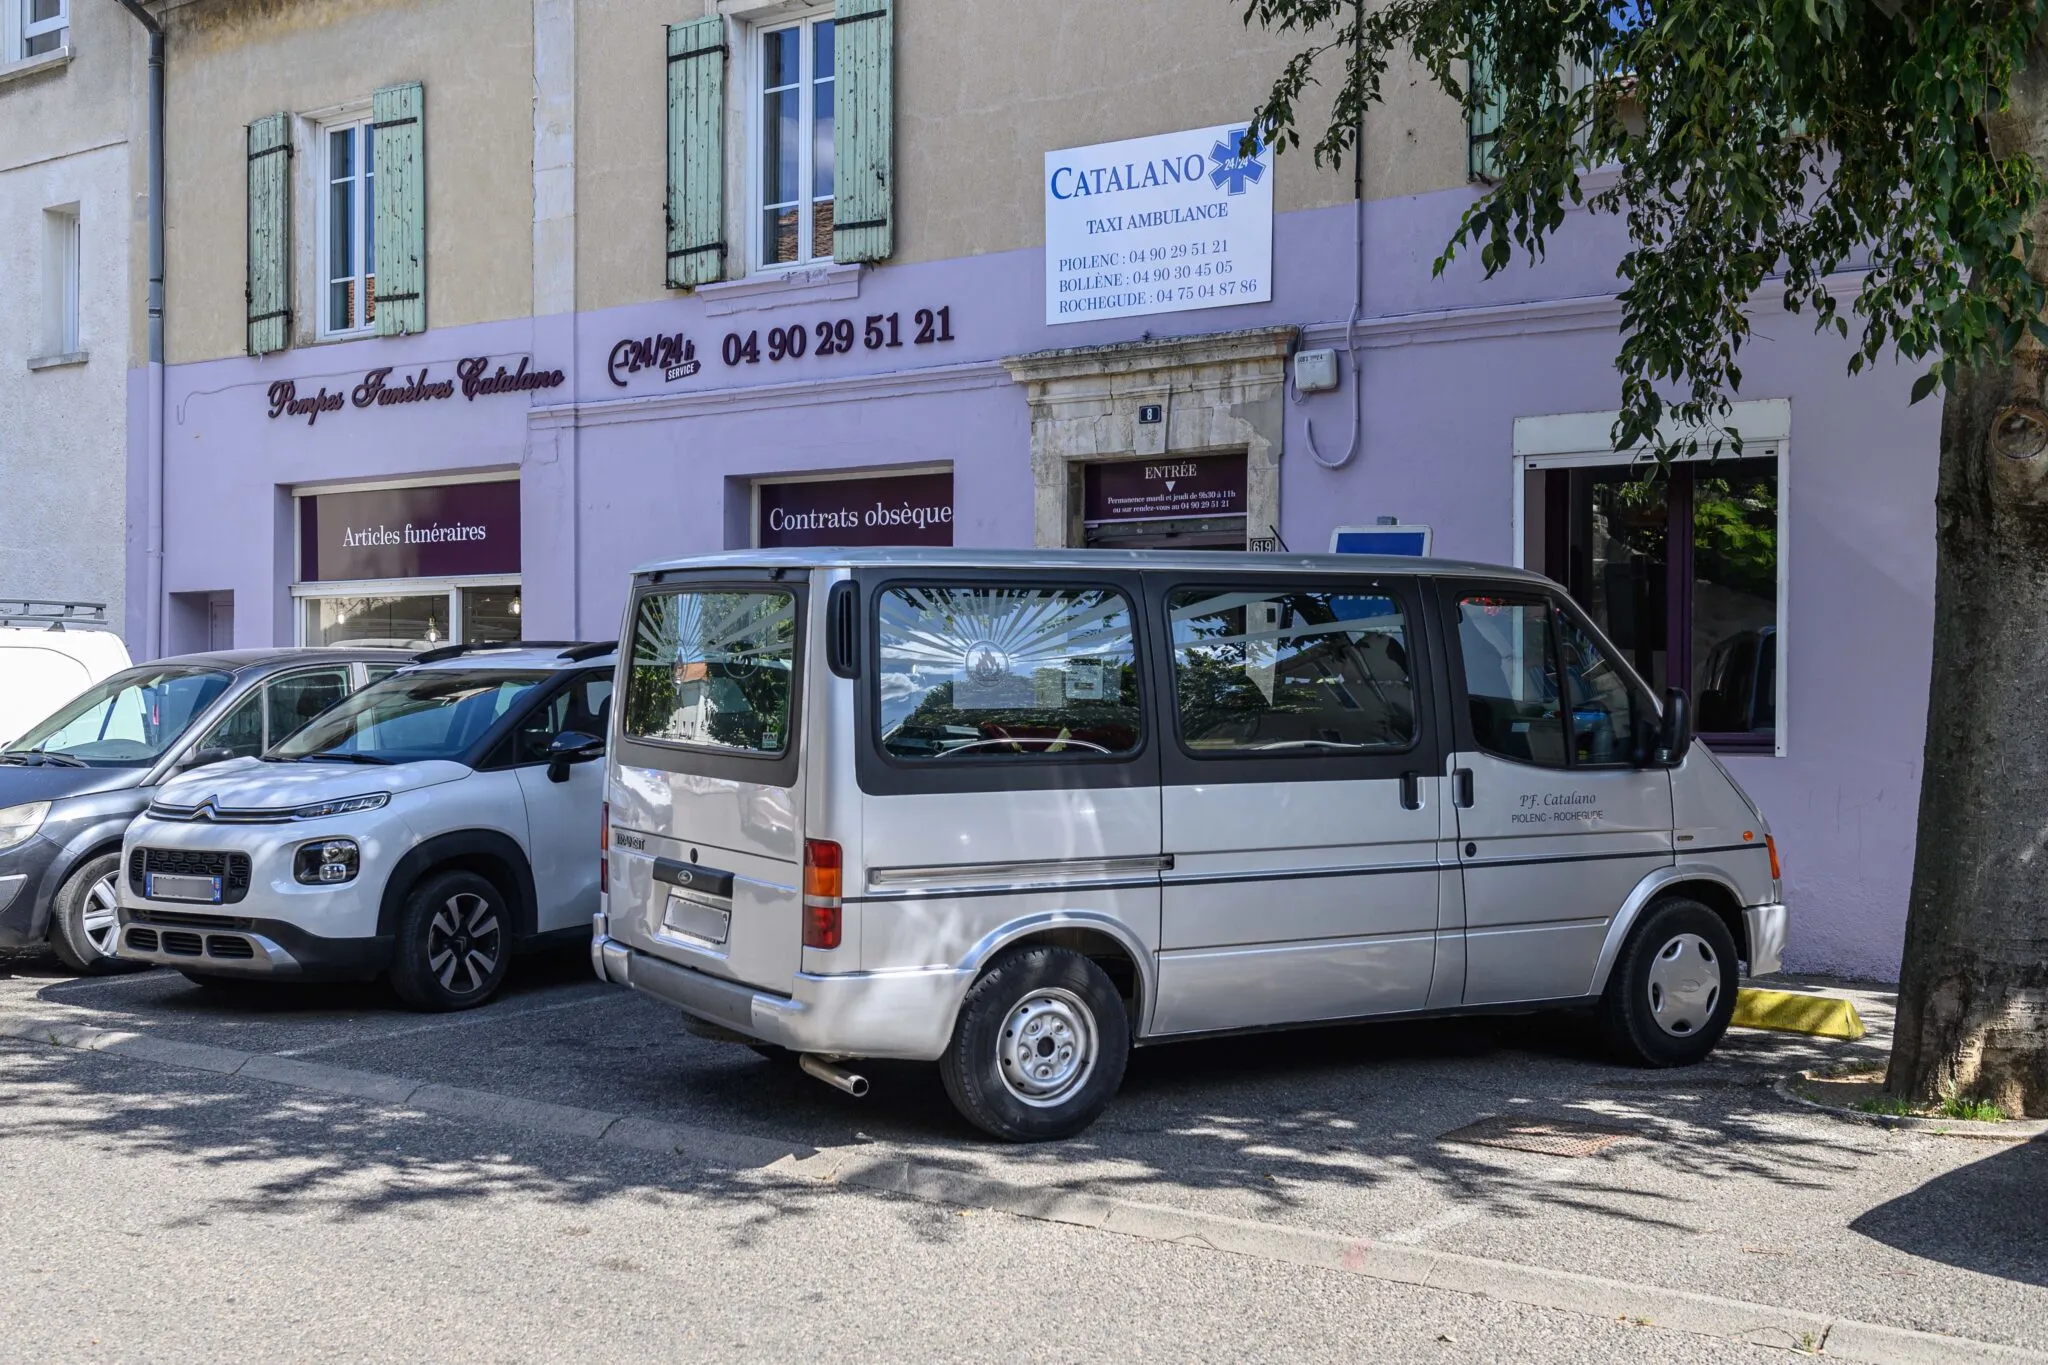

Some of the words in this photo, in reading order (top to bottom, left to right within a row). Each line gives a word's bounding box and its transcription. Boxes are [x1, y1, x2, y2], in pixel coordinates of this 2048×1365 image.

[1051, 154, 1205, 200] CATALANO
[1086, 217, 1123, 235] TAXI
[1127, 202, 1229, 230] AMBULANCE
[1059, 252, 1119, 272] PIOLENC
[1129, 250, 1145, 264] 04
[1150, 247, 1166, 261] 90
[1170, 244, 1187, 259] 29
[1191, 241, 1207, 256] 51
[1212, 239, 1228, 254] 21
[1059, 270, 1122, 293] BOLLÈNE
[1133, 270, 1150, 285] 04
[1153, 267, 1170, 282] 90
[1174, 264, 1191, 279] 30
[1195, 262, 1212, 276] 45
[1215, 260, 1233, 275] 05
[1059, 291, 1146, 314] ROCHEGUDE
[1156, 289, 1173, 303] 04
[1178, 286, 1194, 301] 75
[1198, 284, 1215, 299] 04
[1219, 281, 1236, 296] 87
[1240, 278, 1257, 293] 86
[722, 329, 761, 367] 04
[767, 323, 807, 362] 90
[815, 318, 855, 356] 29
[864, 312, 903, 350] 51
[914, 305, 955, 345] 21
[668, 362, 695, 380] SERVICE
[267, 380, 345, 426] Pompes
[352, 366, 455, 408] Funèbres
[457, 356, 566, 402] Catalano
[1146, 408, 1153, 421] 8
[1145, 460, 1197, 480] ENTRÉE
[1108, 495, 1146, 505] Permanence
[1146, 494, 1165, 503] mardi
[1173, 492, 1189, 503] jeudi
[1198, 491, 1216, 499] 9h30
[1223, 490, 1236, 498] 11h
[1133, 503, 1171, 513] rendez-vous
[1210, 500, 1219, 508] 51
[1221, 499, 1230, 507] 21
[769, 506, 859, 531] Contrats
[342, 526, 400, 547] Articles
[404, 521, 486, 545] funéraires
[1253, 540, 1272, 553] 619
[1543, 790, 1596, 806] Catalano
[1511, 812, 1547, 823] PIOLENC
[1553, 810, 1604, 822] ROCHEGUDE
